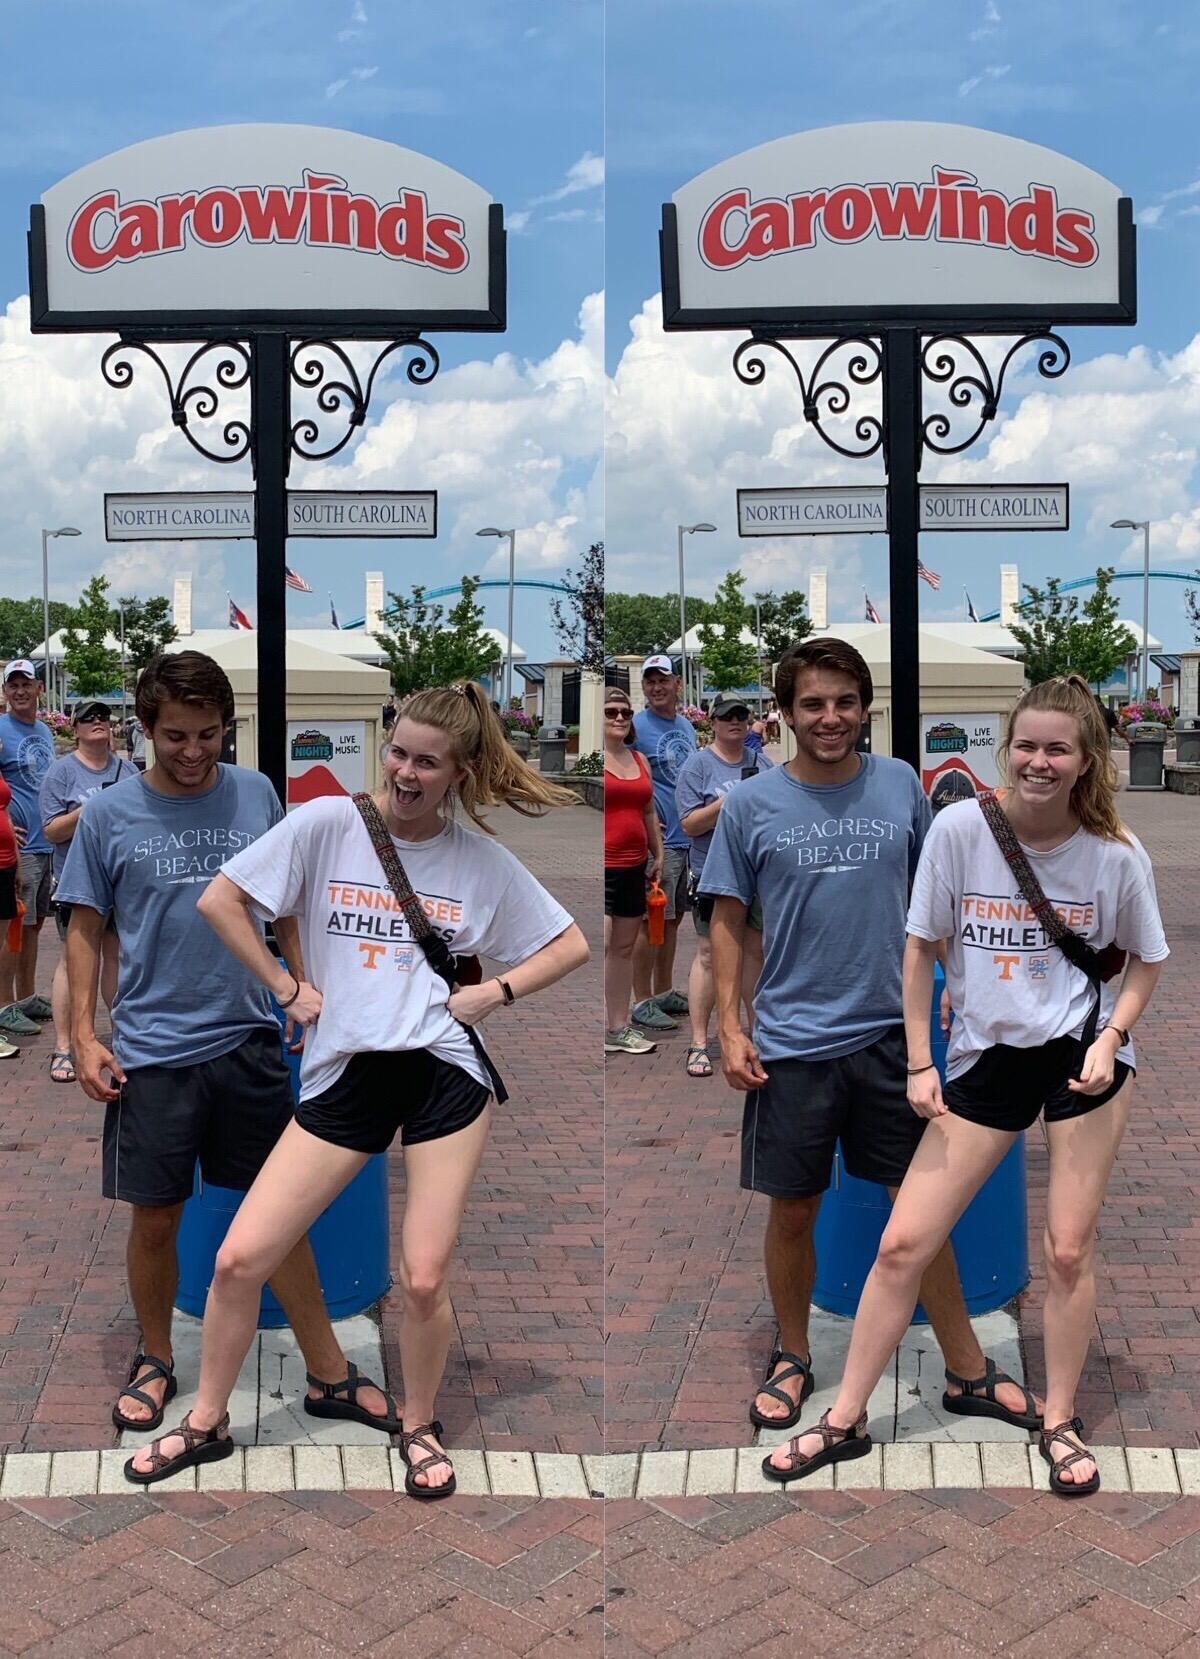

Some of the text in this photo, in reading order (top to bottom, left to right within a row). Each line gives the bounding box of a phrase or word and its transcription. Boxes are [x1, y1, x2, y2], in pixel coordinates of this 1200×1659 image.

[68, 170, 469, 273] Carowinds
[699, 166, 1099, 270] Carowinds
[112, 507, 251, 526] NORTH CAROLINA
[293, 503, 427, 523] SOUTH CAROLINA
[745, 502, 883, 522] NORTH CAROLINA
[925, 497, 1060, 518] SOUTH CAROLINA
[339, 735, 356, 744] LIVE
[974, 727, 991, 737] LIVE
[294, 745, 331, 758] NIGHTS
[335, 745, 361, 755] MUSIC!
[929, 738, 965, 750] NIGHTS
[134, 828, 256, 862] SEACREST
[776, 818, 899, 852] SEACREST
[797, 842, 880, 867] BEACH
[328, 886, 463, 922] TENNESEE
[962, 898, 1094, 927] TENNESEE
[359, 943, 387, 970] T
[993, 955, 1020, 980] T
